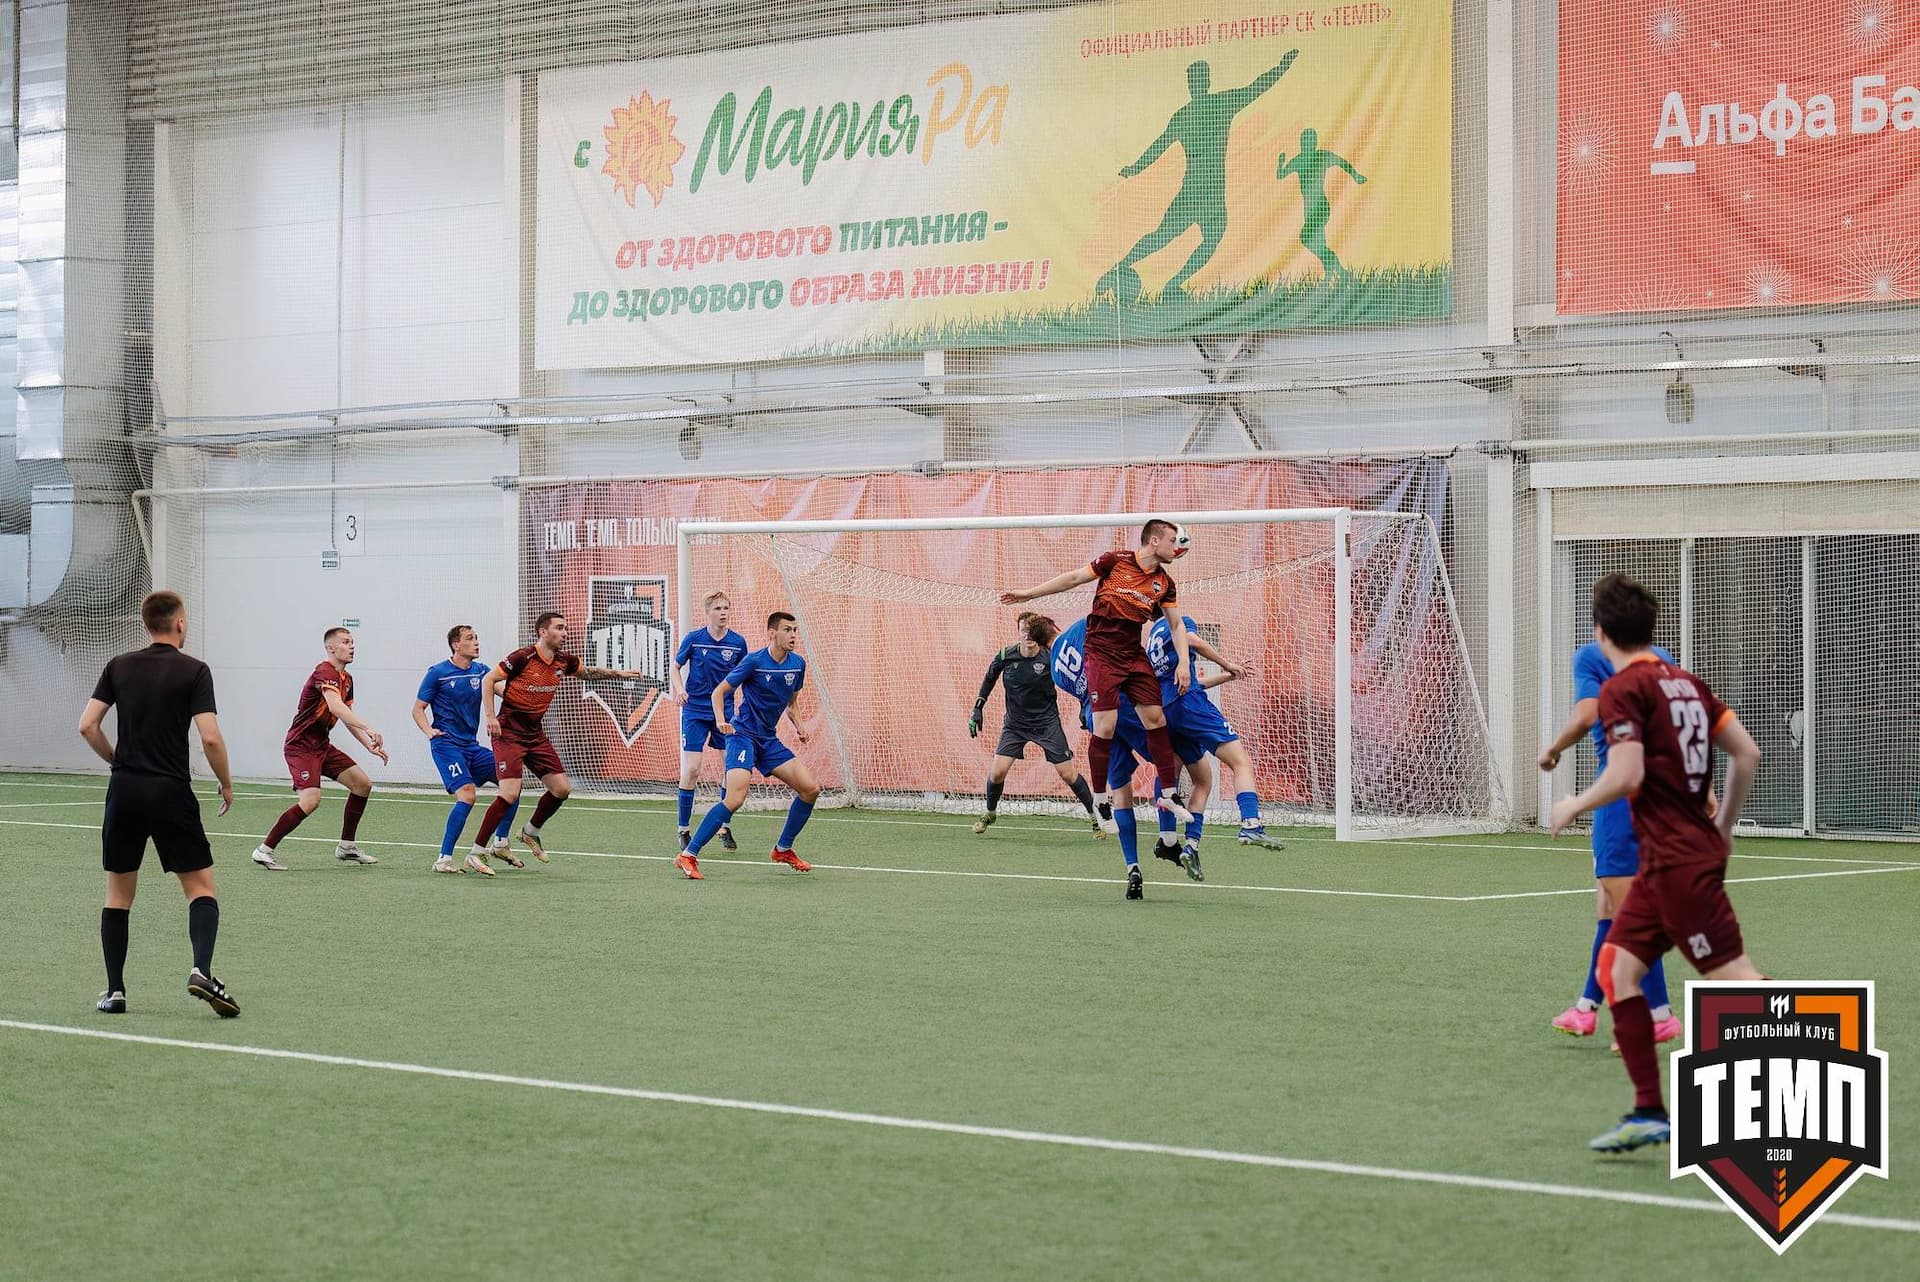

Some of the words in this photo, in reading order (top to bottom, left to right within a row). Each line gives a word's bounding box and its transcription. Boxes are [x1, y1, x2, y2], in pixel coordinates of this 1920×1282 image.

[1079, 19, 1211, 58] ОФИЦИАЛЬНЫЙ
[1217, 15, 1289, 42] ПАРТНЕР
[1295, 11, 1315, 32] СК
[1321, 2, 1392, 28] «ТЕМП»
[1652, 82, 1837, 157] Альфа
[615, 239, 654, 269] ОТ
[657, 225, 833, 271] ЗДОРОВОГО
[839, 210, 988, 252] ПИТАНИЯ
[567, 290, 609, 325] ДО
[613, 279, 784, 322] ЗДОРОВОГО
[790, 270, 905, 308] ОБРАЗА
[346, 514, 358, 541] 3
[592, 624, 665, 682] ТЕМП
[1055, 639, 1082, 682] 15
[737, 750, 746, 763] 4
[1669, 699, 1709, 775] 23
[449, 762, 463, 778] 21
